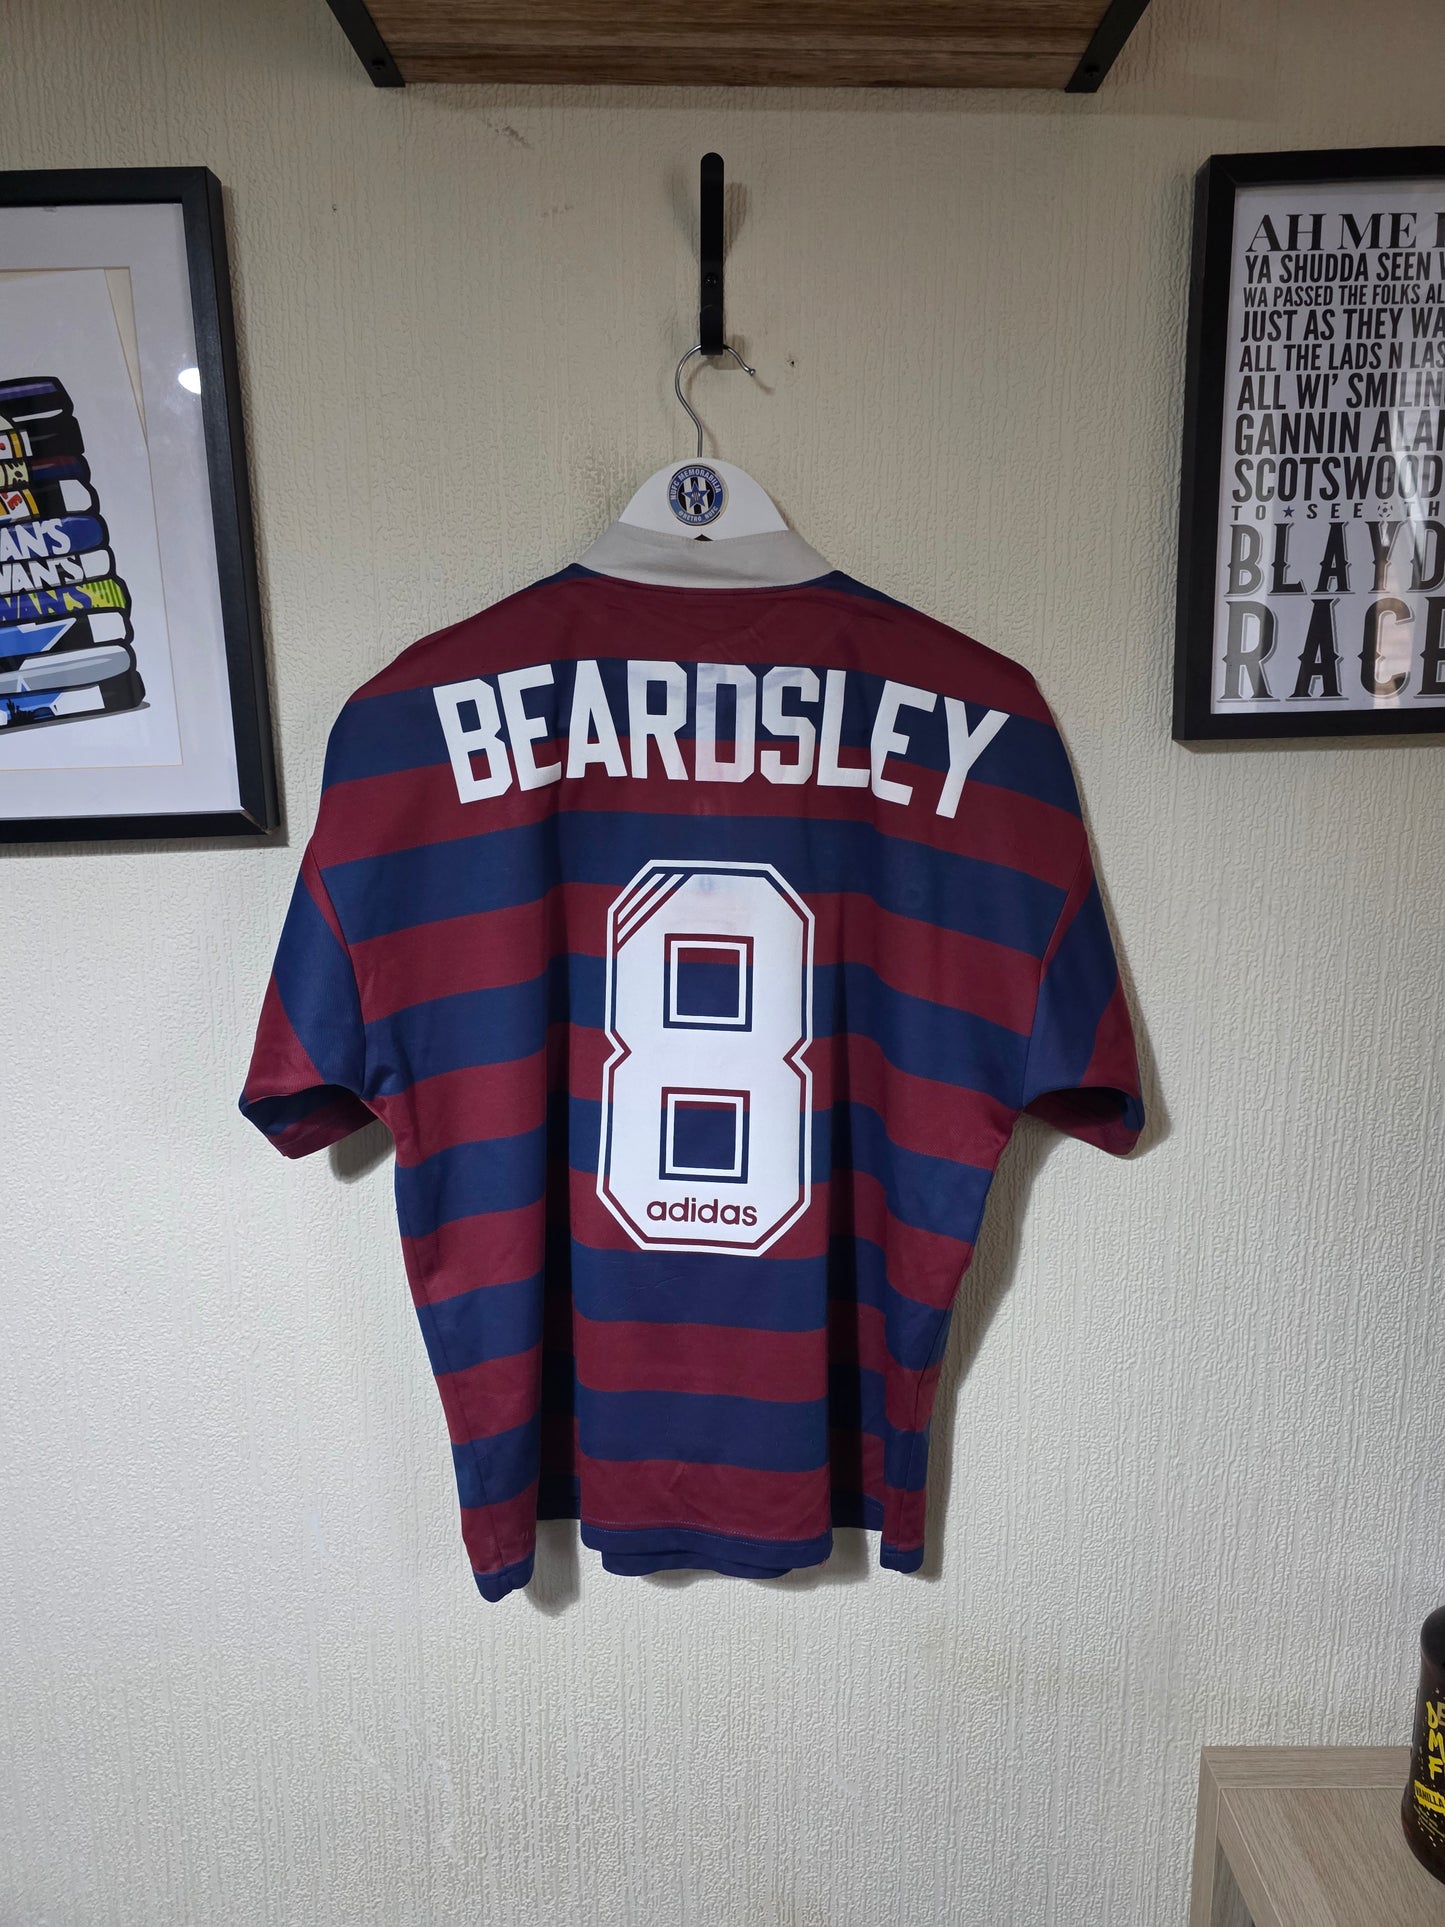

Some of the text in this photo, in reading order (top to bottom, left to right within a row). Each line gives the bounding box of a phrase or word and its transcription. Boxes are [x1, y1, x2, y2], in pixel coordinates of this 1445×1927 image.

[1246, 213, 1326, 252] AH
[1338, 212, 1418, 250] ME
[1245, 255, 1272, 284] YA
[1279, 253, 1368, 283] SHUDDA
[1376, 252, 1431, 282] SEEN
[1243, 286, 1268, 308] WA
[1273, 285, 1333, 307] PASSED
[1339, 284, 1367, 306] THE
[1372, 283, 1421, 305] FOLKS
[1240, 309, 1298, 342] JUST
[1303, 308, 1335, 341] AS
[1343, 308, 1403, 340] THEY
[1239, 345, 1277, 372] ALL
[1283, 343, 1321, 371] THE
[1328, 342, 1382, 370] LADS
[1388, 342, 1403, 369] N
[1237, 374, 1286, 411] ALL
[1234, 411, 1361, 455] GANNIN
[1231, 454, 1443, 502] SCOTSWOOD
[1231, 504, 1267, 521] TO
[1306, 502, 1363, 519] SEE
[432, 658, 1010, 819] BEARDSLEY
[596, 860, 815, 1257] 8
[646, 1197, 758, 1227] adidas
